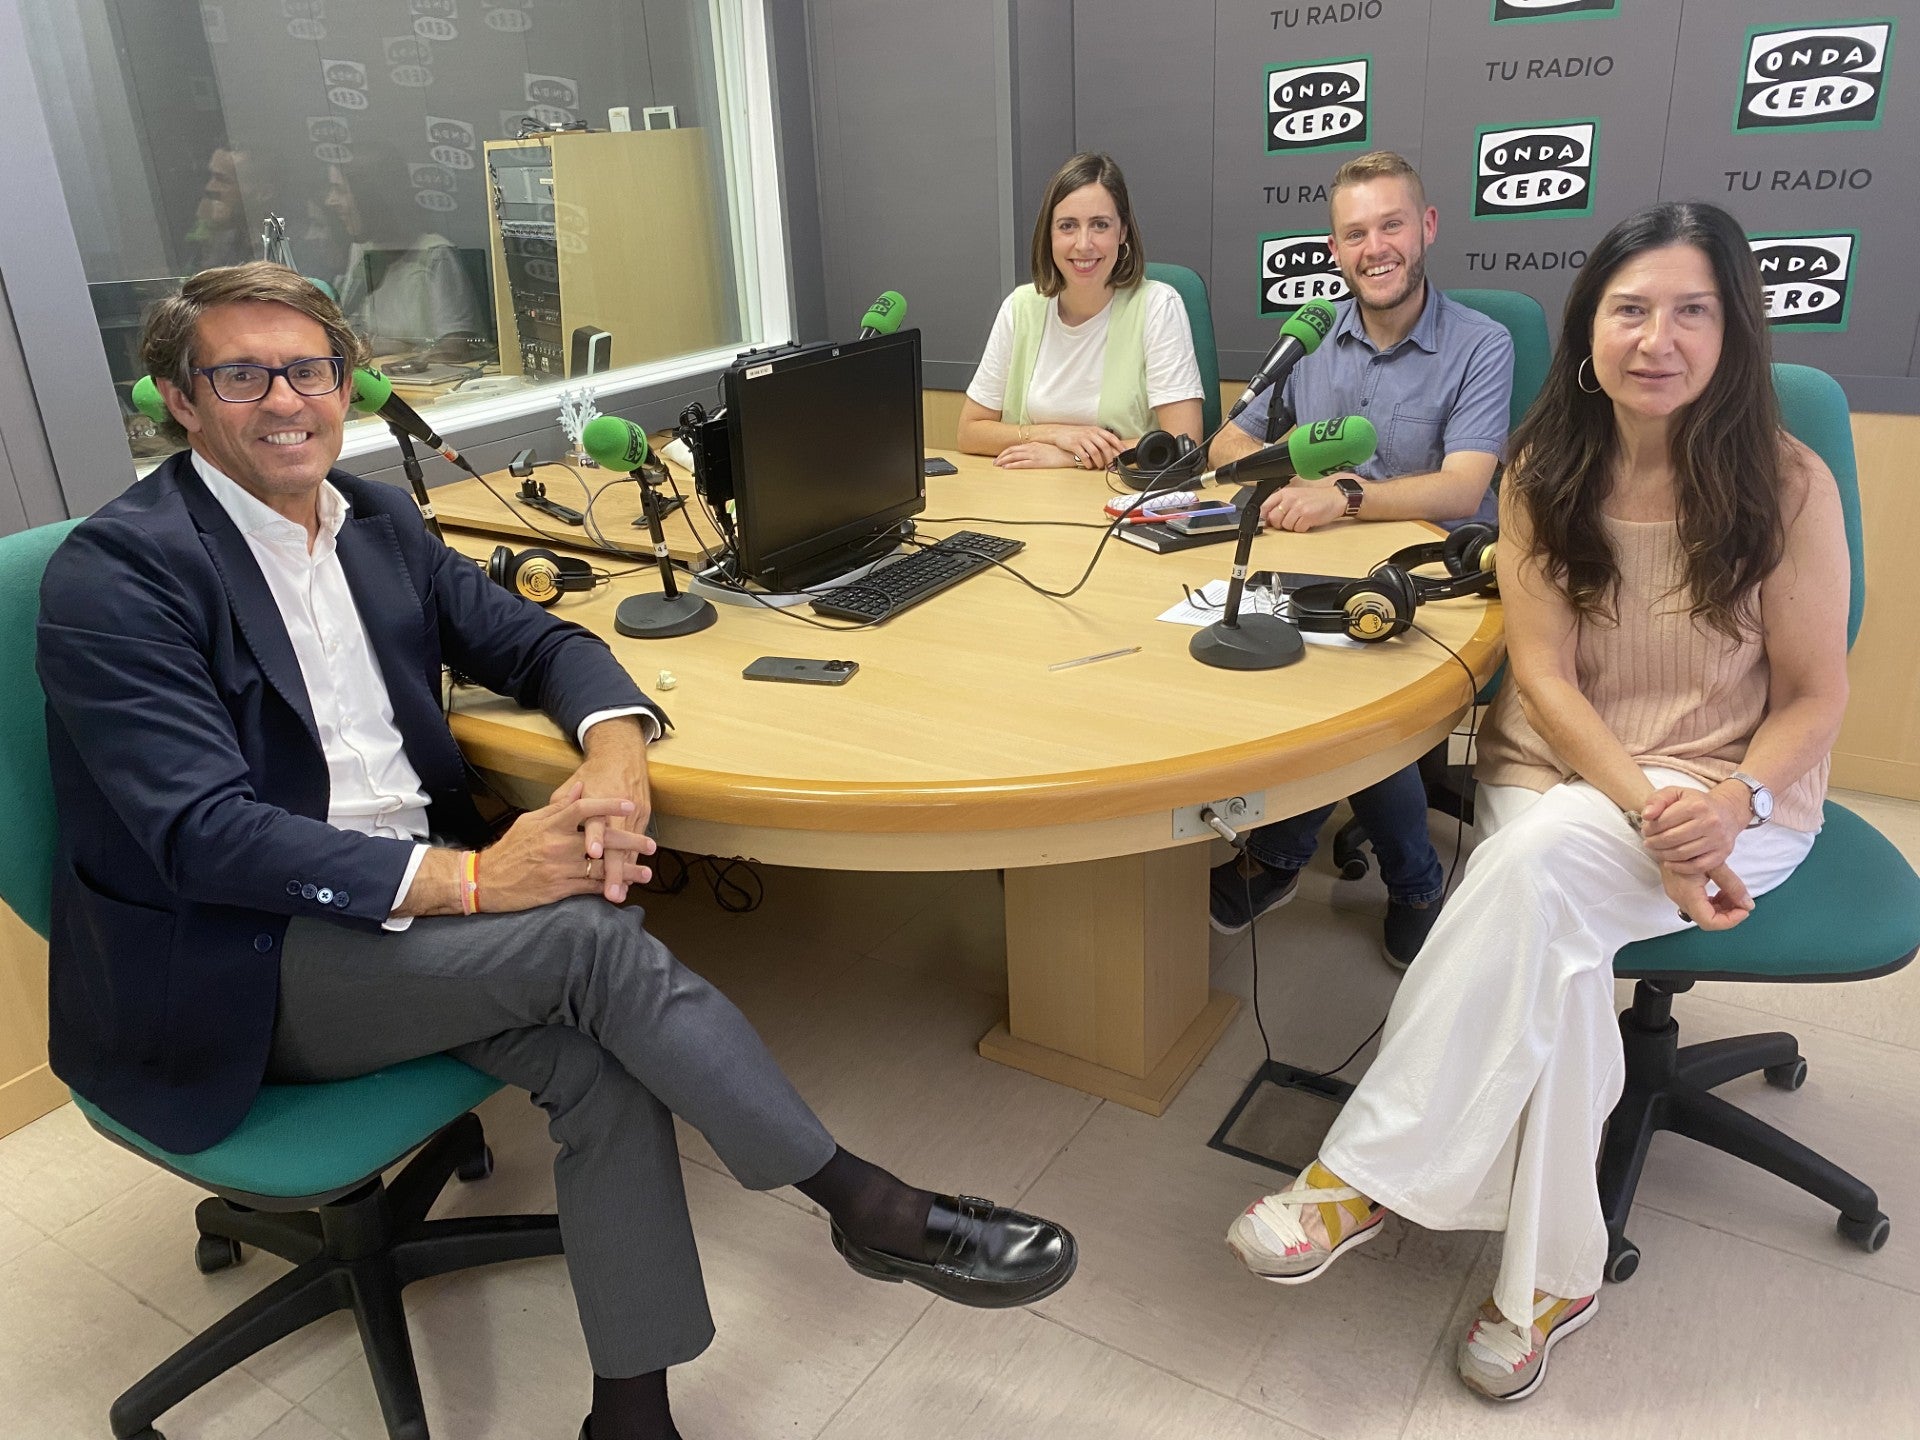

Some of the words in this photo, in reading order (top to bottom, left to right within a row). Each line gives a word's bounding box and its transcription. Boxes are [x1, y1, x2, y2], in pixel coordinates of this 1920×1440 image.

[1270, 9, 1299, 30] TU
[1306, 0, 1382, 26] RADIO
[1485, 61, 1519, 81] TU
[1526, 56, 1614, 79] RADIO
[1766, 46, 1863, 71] ONDA
[1281, 80, 1351, 103] ONDA
[1765, 85, 1858, 109] CERO
[1285, 112, 1351, 135] CERO
[1494, 144, 1574, 165] ONDA
[1496, 178, 1572, 199] CERO
[1724, 171, 1762, 191] TU
[1770, 168, 1872, 191] RADIO
[1263, 186, 1290, 204] TU
[1466, 252, 1497, 271] TU
[1505, 250, 1587, 270] RADIO
[1759, 255, 1828, 272] NDA
[1278, 281, 1341, 299] CERO
[1762, 289, 1825, 310] ERO
